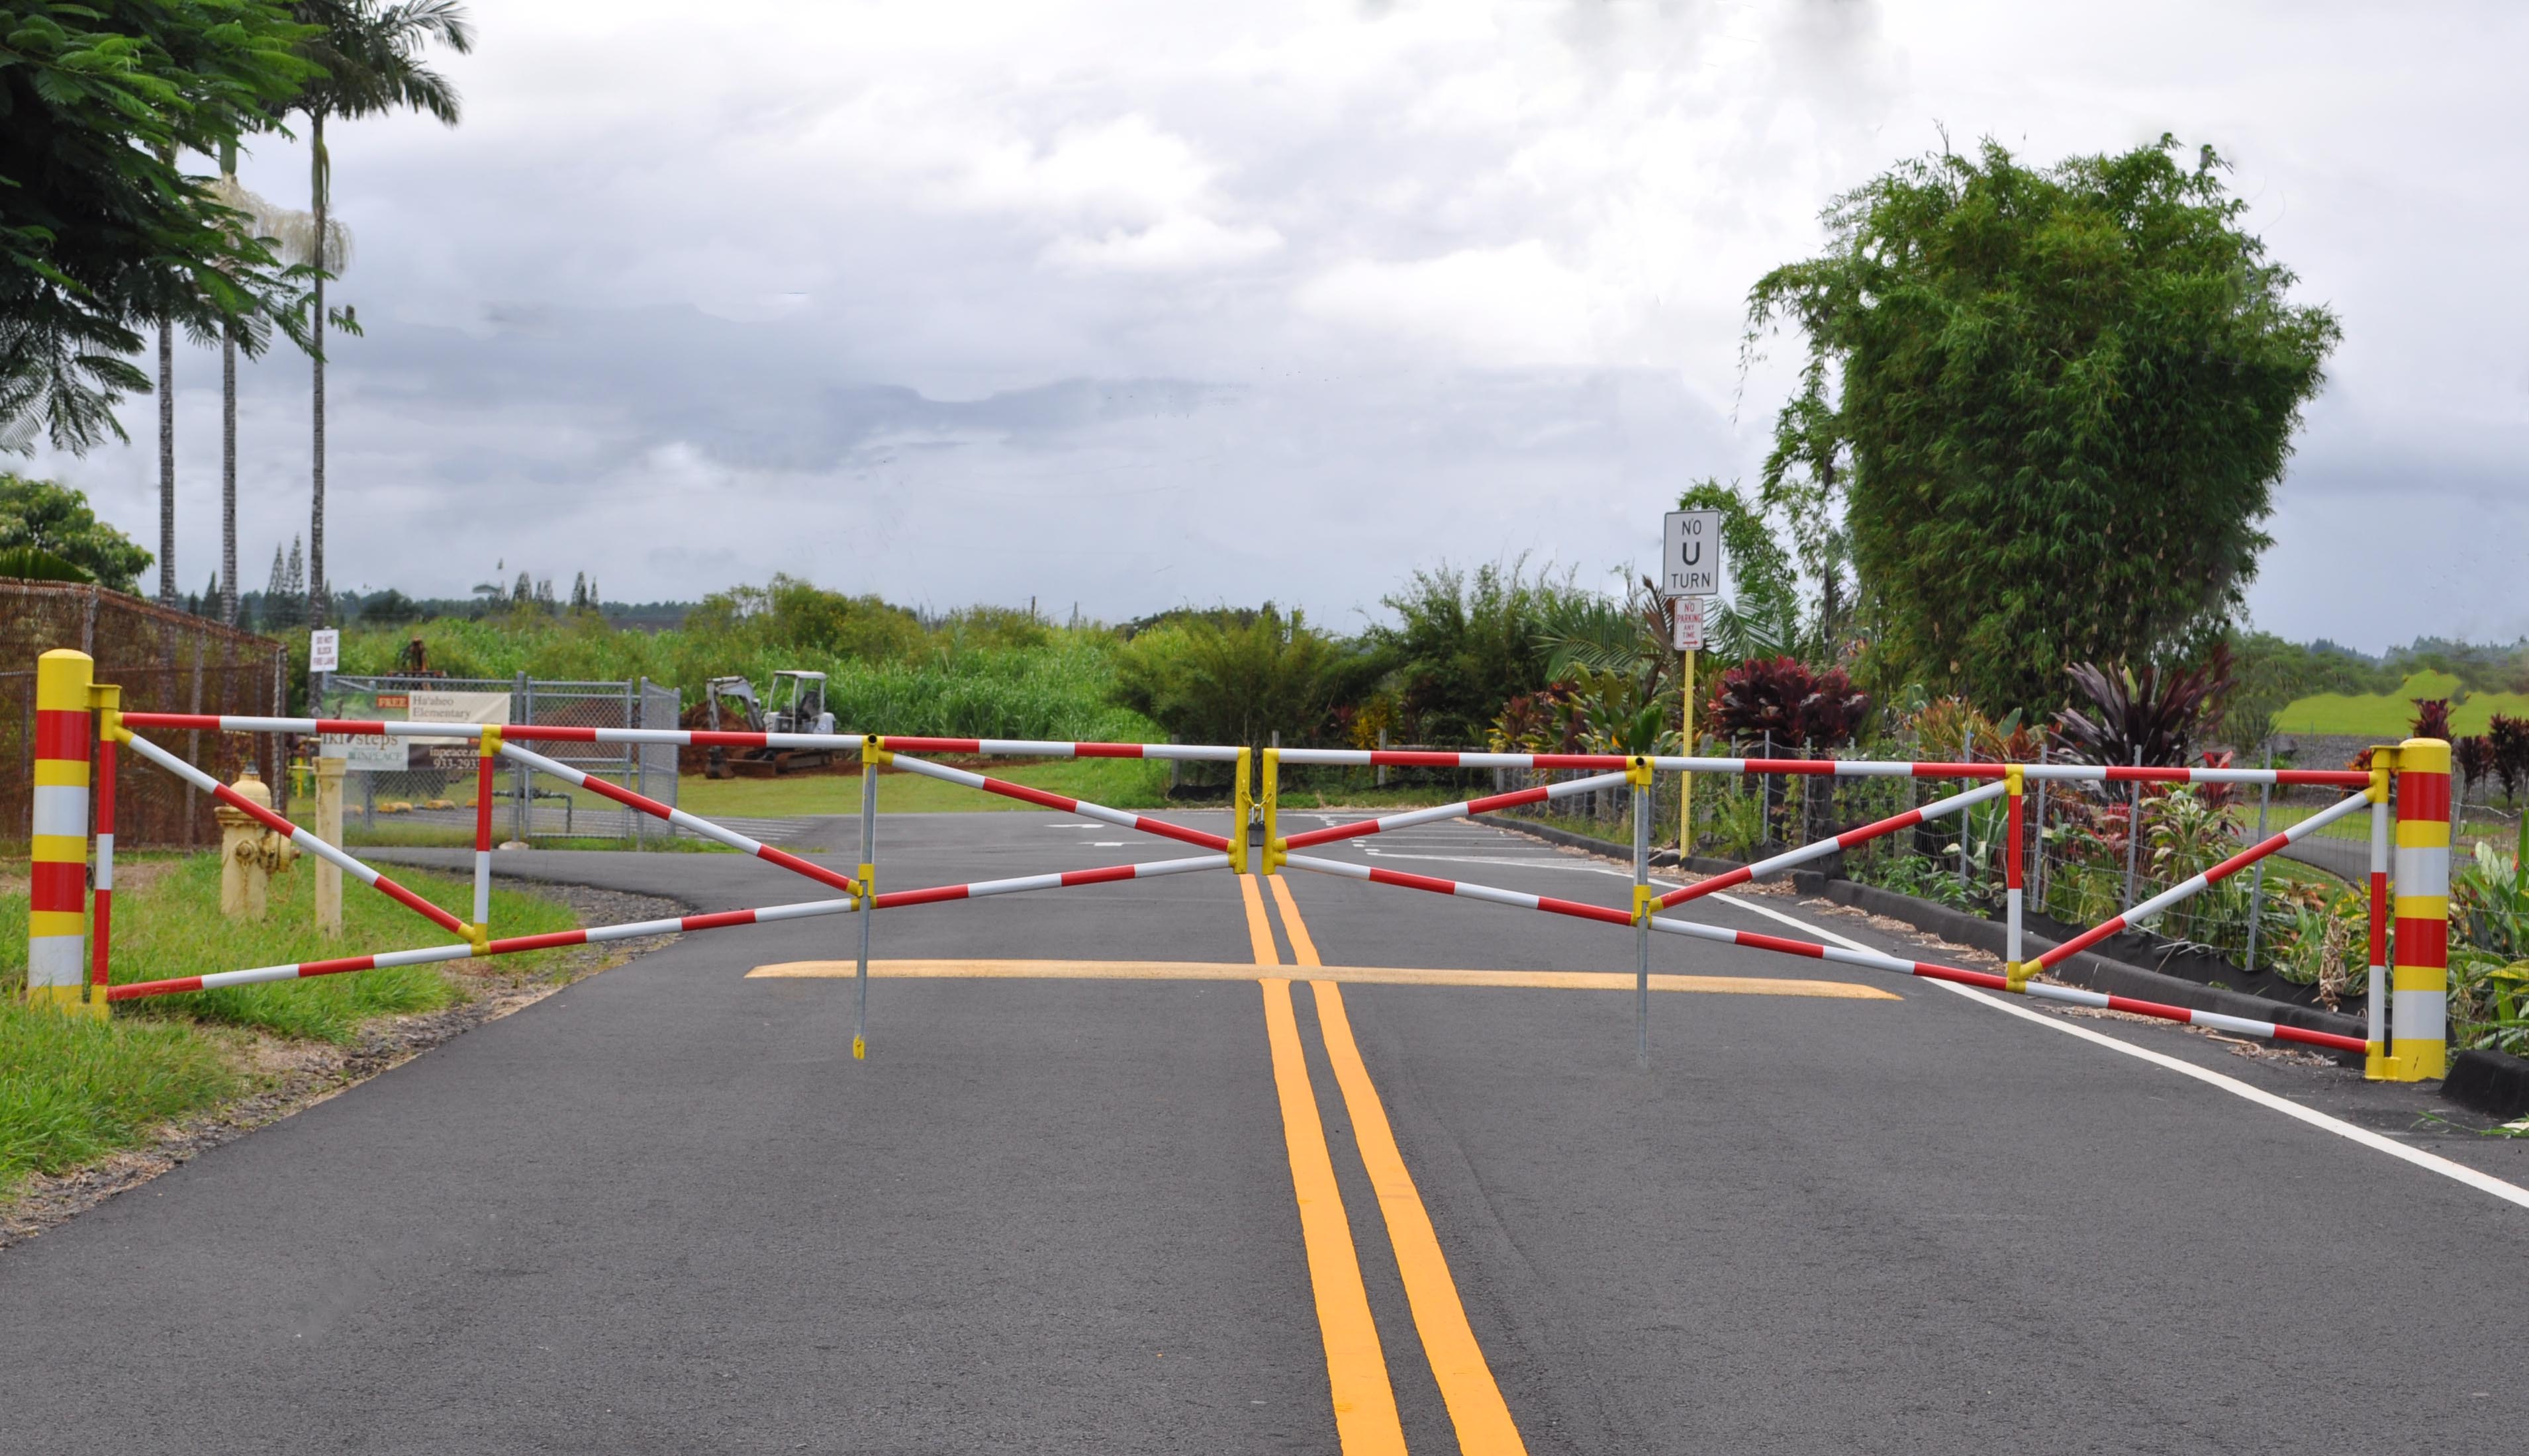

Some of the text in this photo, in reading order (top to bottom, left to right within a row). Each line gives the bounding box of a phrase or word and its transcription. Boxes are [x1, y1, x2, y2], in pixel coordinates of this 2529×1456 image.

[1682, 520, 1701, 535] NO
[1682, 541, 1700, 566] U
[1671, 572, 1710, 588] TURN
[1684, 603, 1695, 612] NO
[1677, 614, 1701, 623] PARKING
[378, 697, 406, 707] FREE
[413, 707, 471, 719] Elementary
